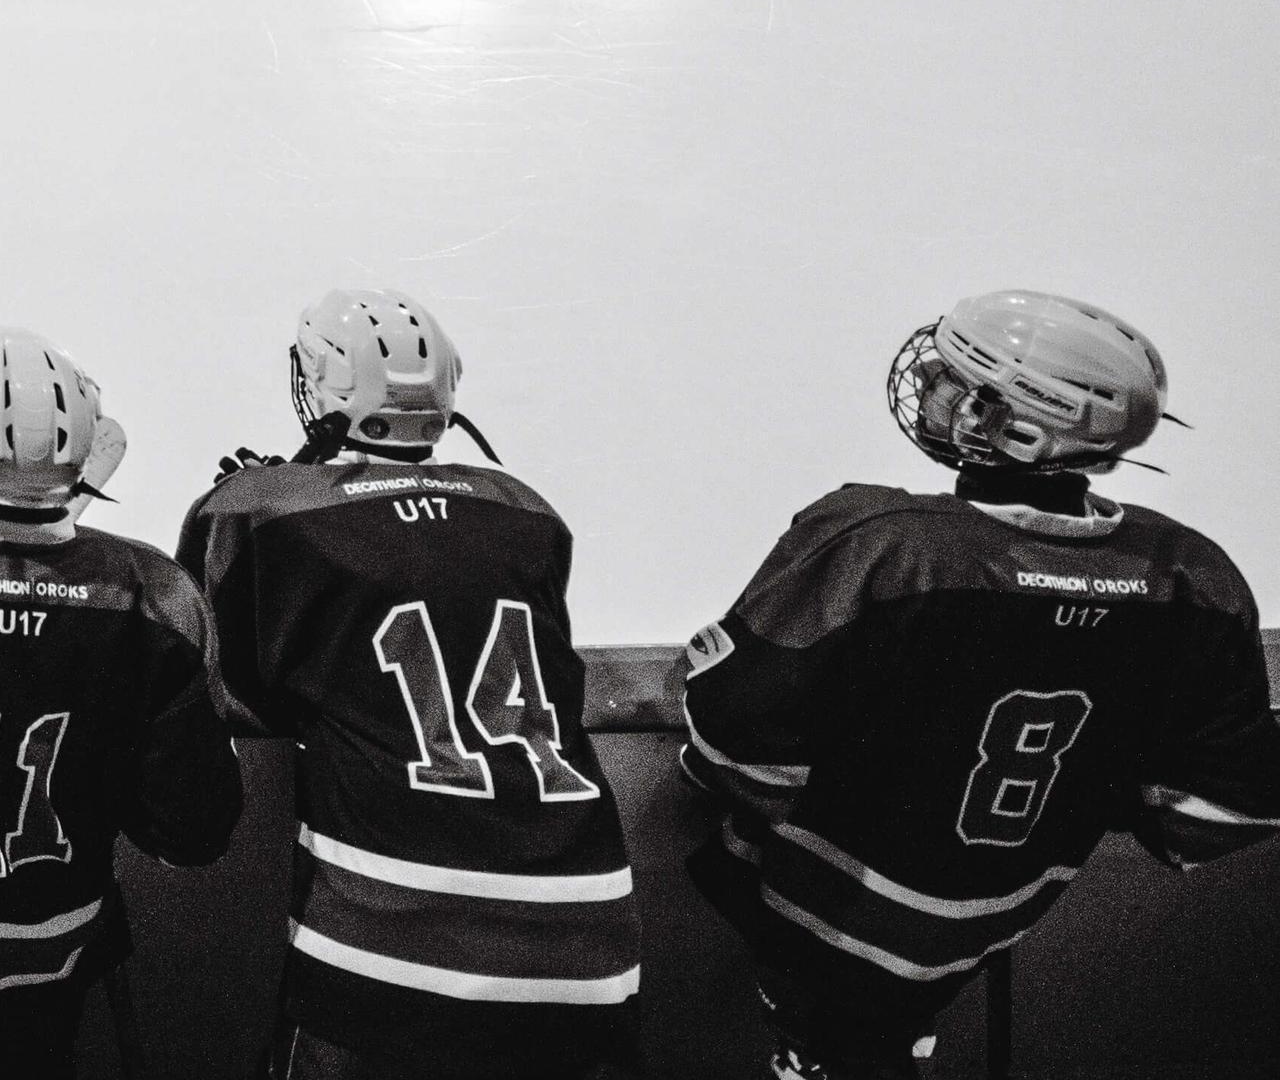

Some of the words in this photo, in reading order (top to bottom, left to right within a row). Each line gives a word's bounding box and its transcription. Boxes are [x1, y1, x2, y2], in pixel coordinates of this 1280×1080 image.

[343, 476, 419, 496] DECATHLON
[393, 496, 448, 523] U17
[36, 582, 89, 599] OROKS
[1017, 571, 1088, 592] DECATHLON
[1093, 578, 1149, 595] OROKS
[1054, 605, 1111, 627] U17
[372, 598, 601, 803] 14
[955, 689, 1093, 846] 8
